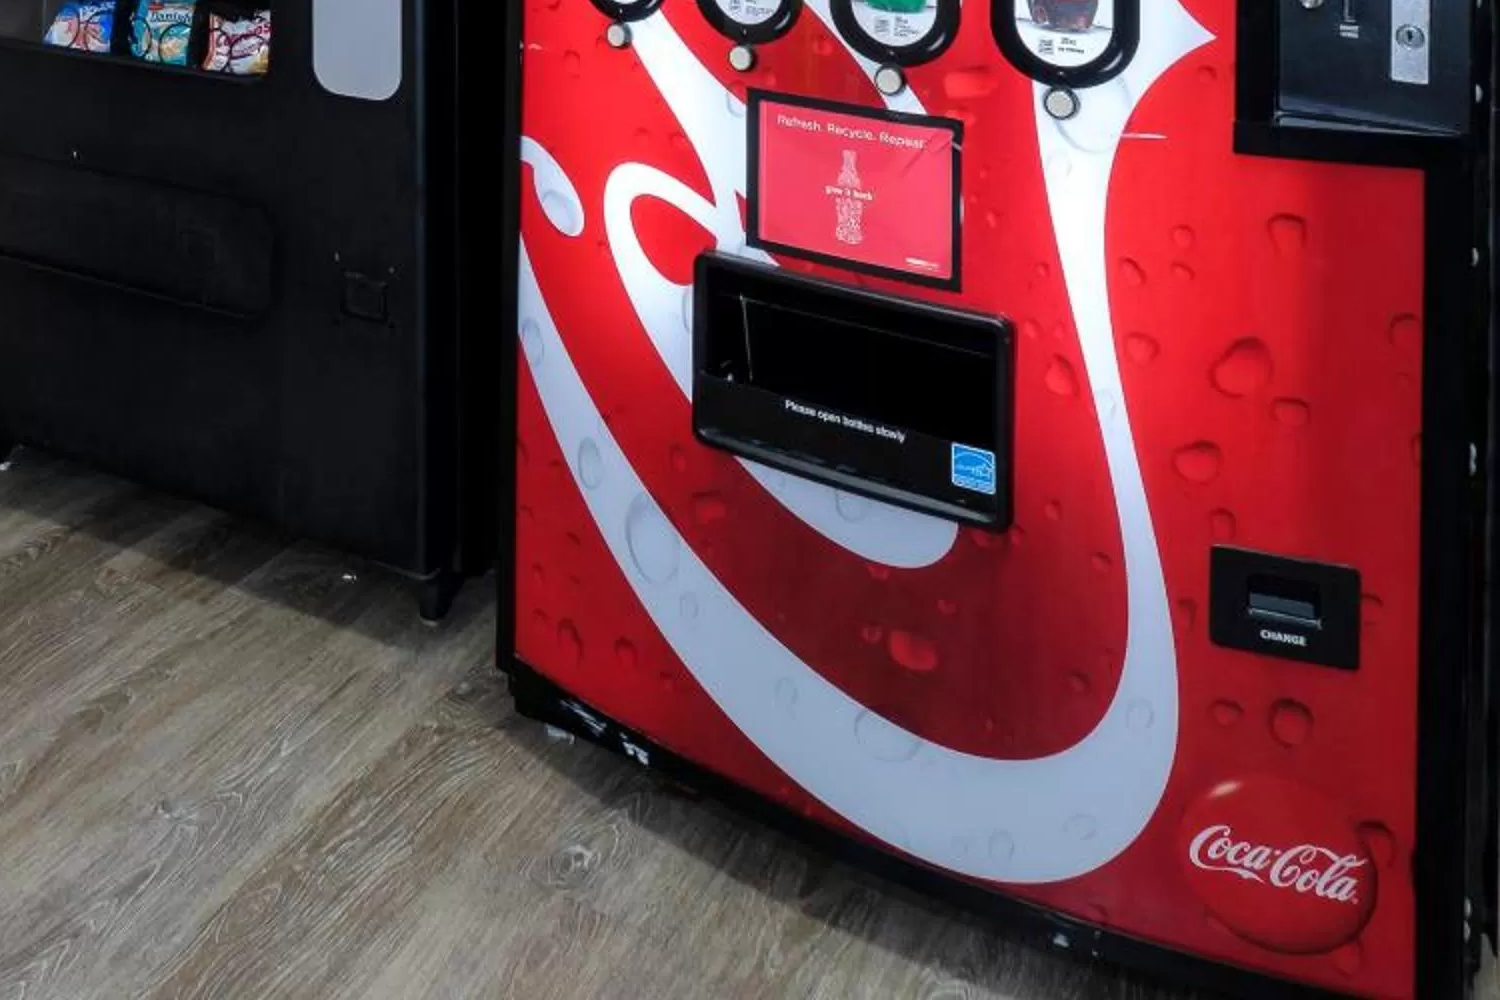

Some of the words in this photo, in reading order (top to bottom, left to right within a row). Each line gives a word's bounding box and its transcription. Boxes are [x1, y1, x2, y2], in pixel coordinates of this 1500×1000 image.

[784, 399, 816, 417] Please
[817, 409, 841, 424] open
[875, 426, 906, 444] slowly
[1260, 629, 1307, 647] CHANGE
[1189, 824, 1368, 904] Coca-Cola
